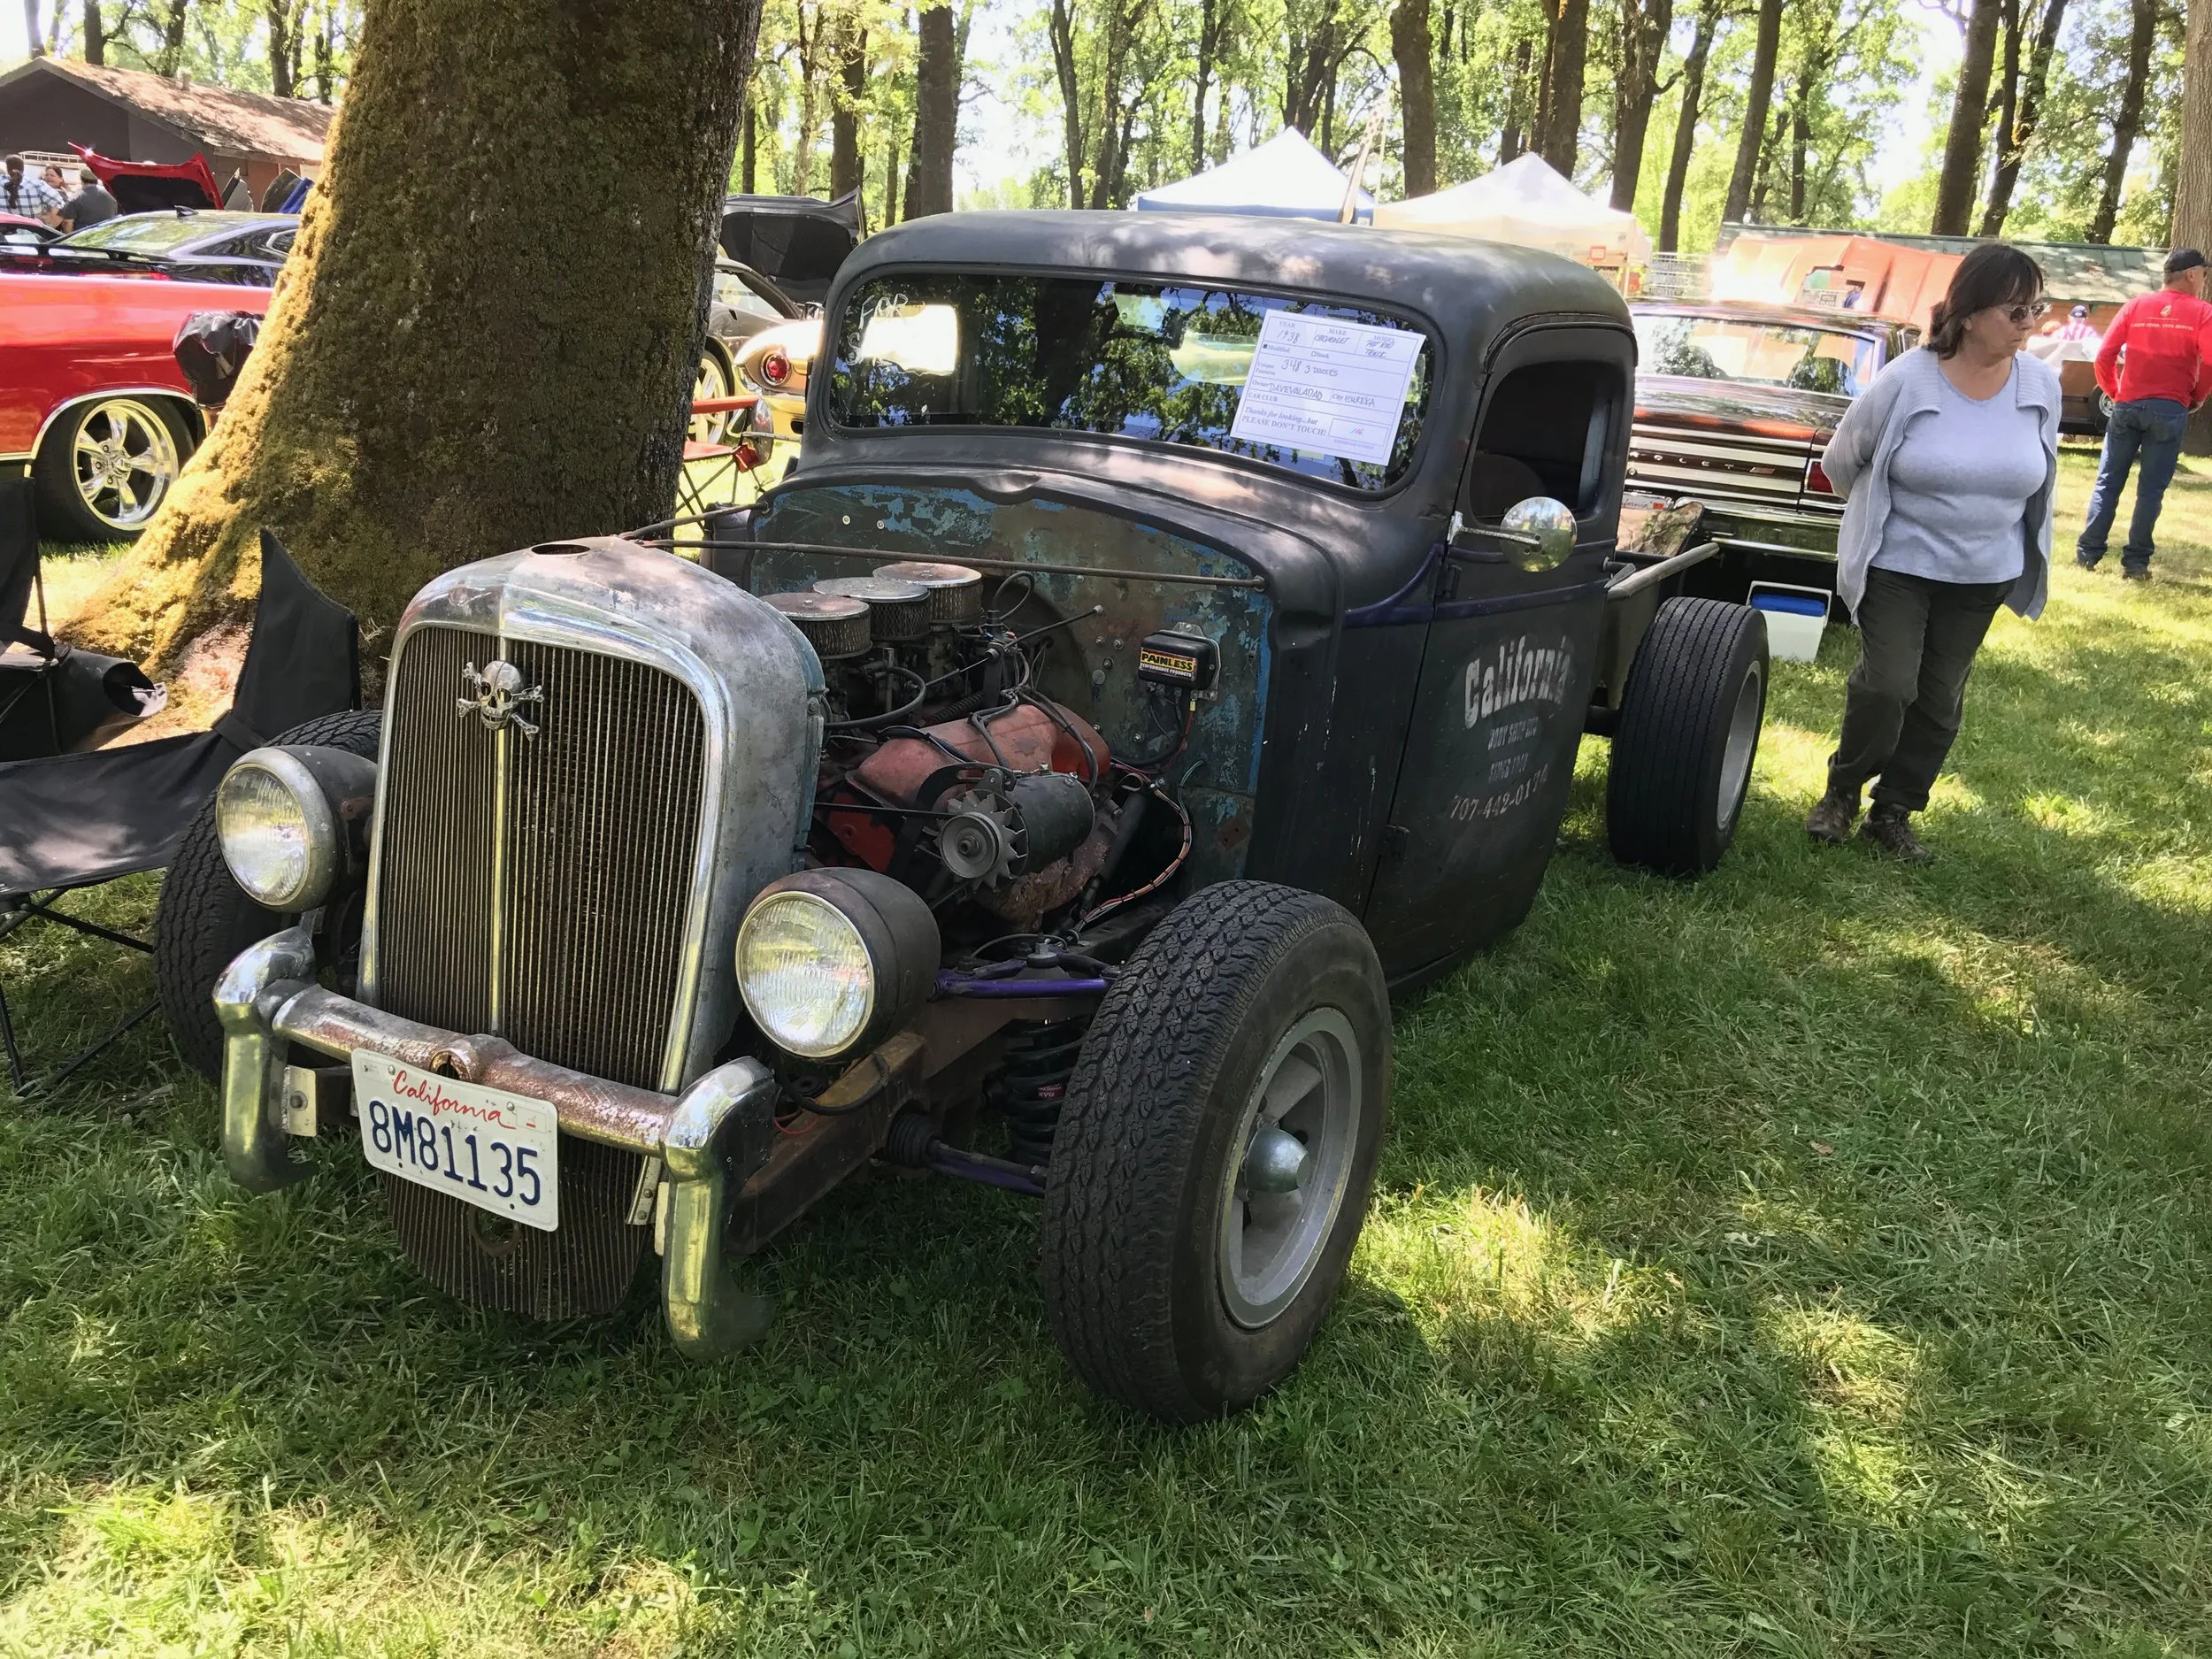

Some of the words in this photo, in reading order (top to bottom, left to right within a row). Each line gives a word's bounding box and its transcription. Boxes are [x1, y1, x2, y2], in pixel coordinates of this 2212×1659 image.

[1276, 329, 1301, 344] 1938
[1280, 358, 1302, 373] 348
[1344, 395, 1375, 408] EUREKA
[1244, 407, 1267, 416] Thanks
[1266, 410, 1279, 419] for
[1241, 415, 1271, 426] PLEASE
[1271, 420, 1296, 431] DON'T
[1296, 425, 1327, 437] TOUCH!
[1141, 652, 1194, 672] PAINLESS
[1169, 668, 1193, 678] PRODUCTS
[1464, 635, 1571, 729] California
[1487, 725, 1509, 750] BODY
[392, 1069, 517, 1130] California
[368, 1100, 541, 1206] 8M81135
